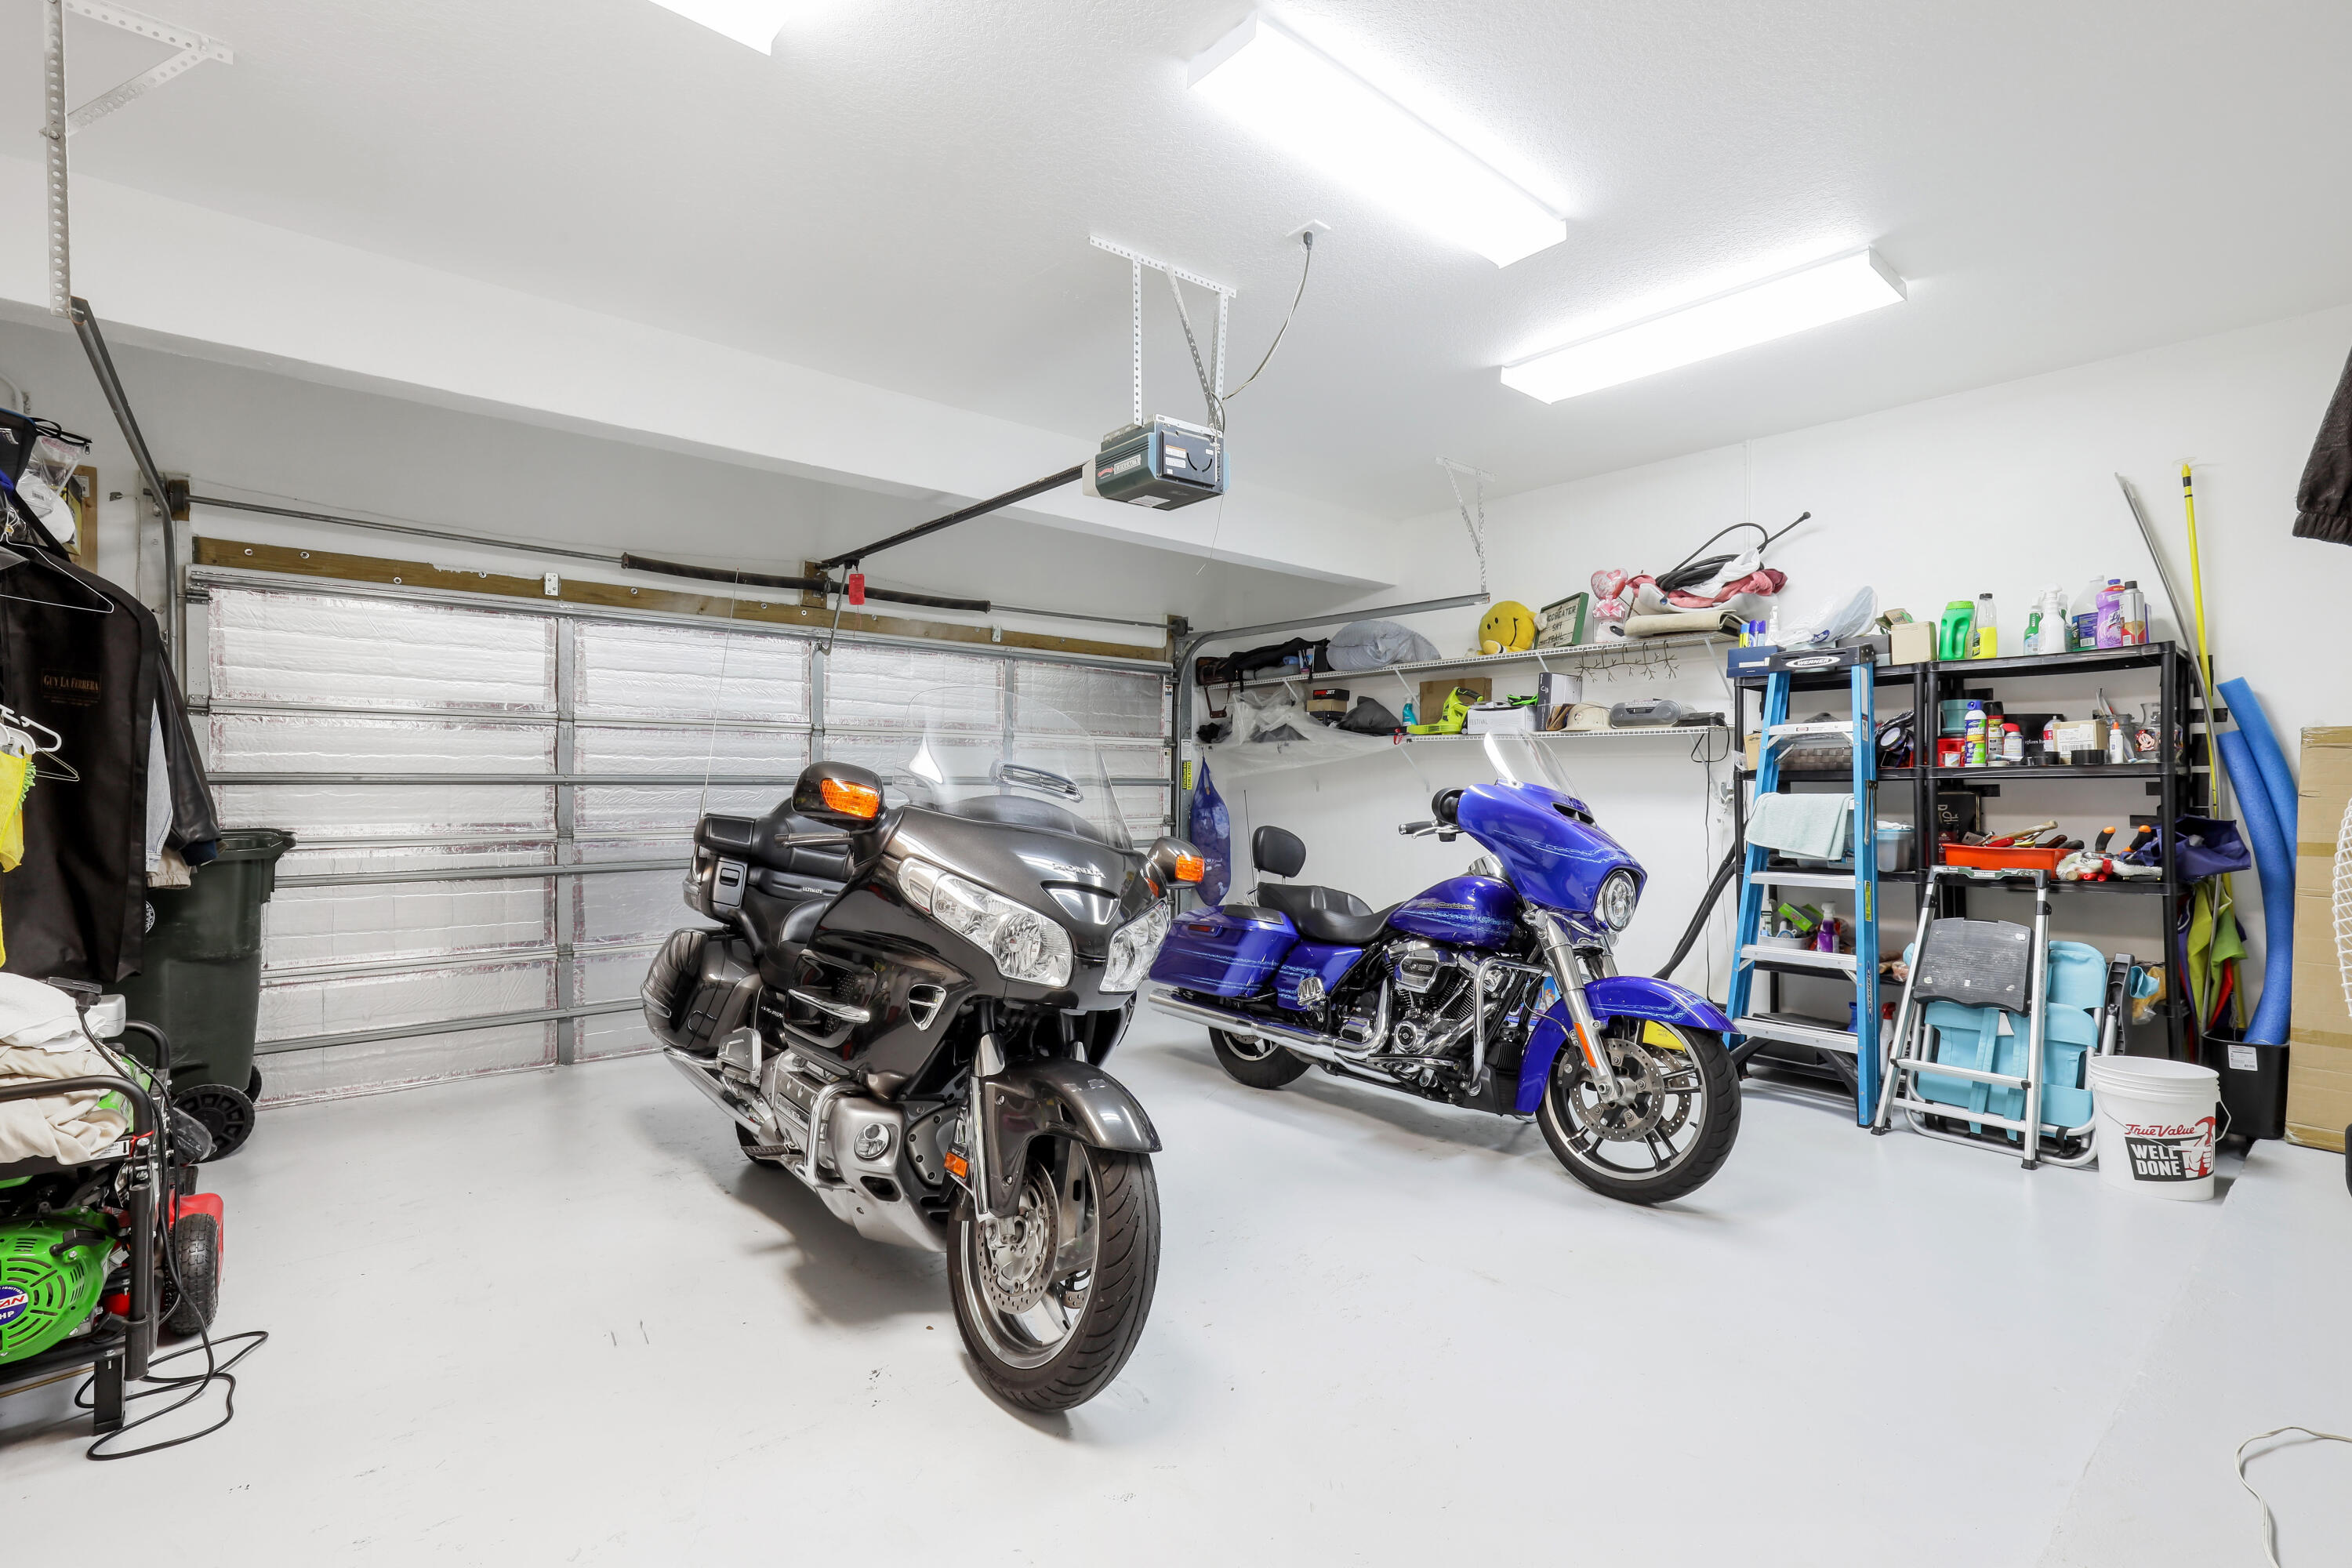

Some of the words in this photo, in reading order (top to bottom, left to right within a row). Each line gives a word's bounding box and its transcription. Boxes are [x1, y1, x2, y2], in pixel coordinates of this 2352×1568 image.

[1052, 863, 1107, 879] HONDA
[2124, 1123, 2158, 1136] True
[2148, 1123, 2196, 1138] Value
[2130, 1143, 2179, 1160] WELL
[2135, 1160, 2182, 1177] DONE
[2, 1286, 24, 1294] IGNITION
